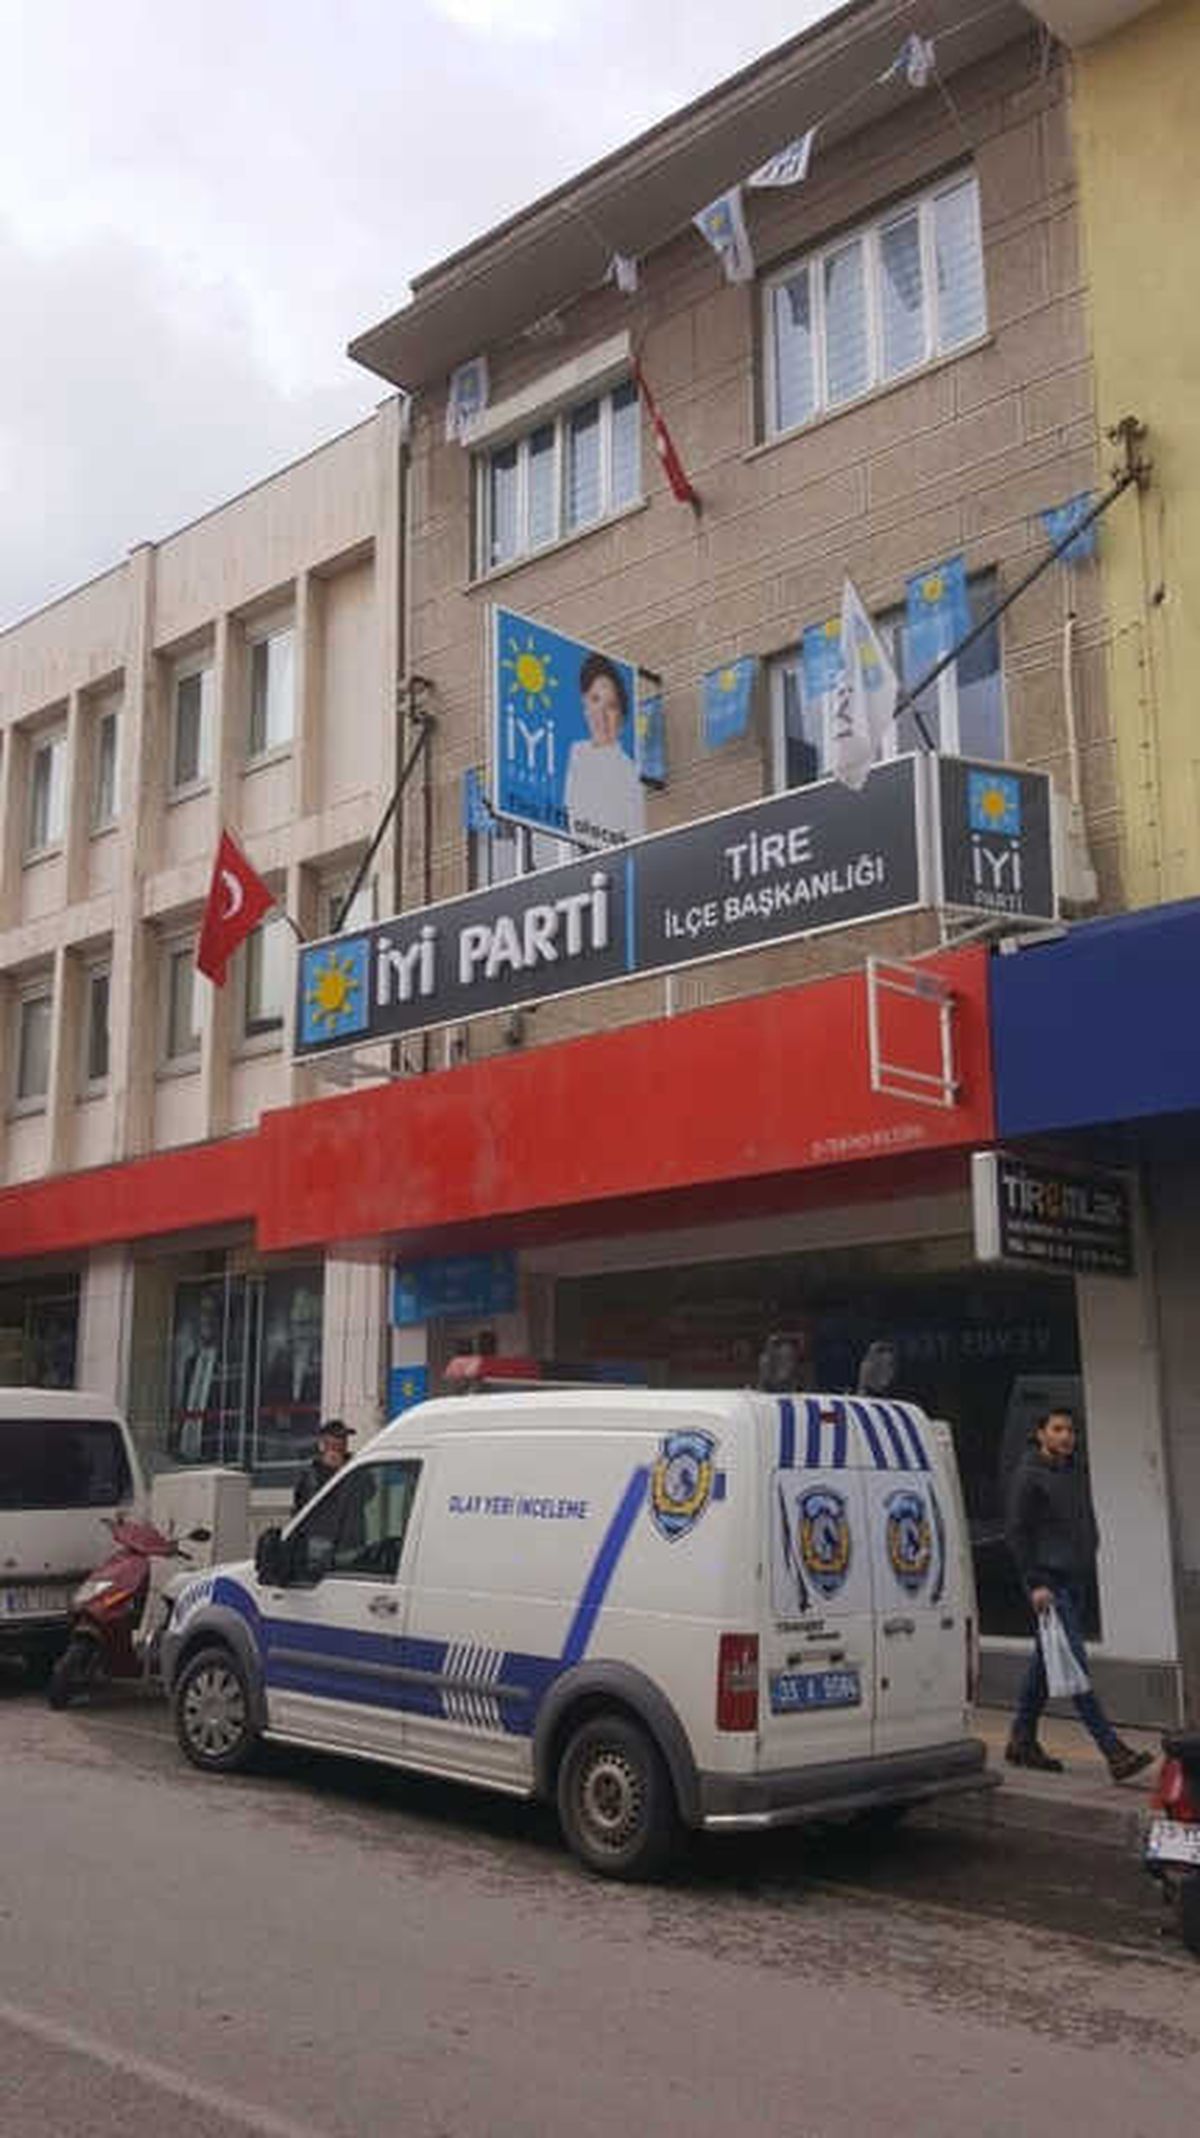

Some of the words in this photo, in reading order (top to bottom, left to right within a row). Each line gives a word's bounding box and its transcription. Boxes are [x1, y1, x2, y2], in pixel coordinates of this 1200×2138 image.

[506, 703, 555, 777] İYİ
[725, 825, 812, 882] TİRE
[972, 833, 1021, 891] İYİ
[665, 902, 718, 938] İLÇE
[724, 853, 885, 921] BAŞKANLIĞI
[377, 925, 436, 1006] İYİ
[459, 870, 610, 983] PARTİ
